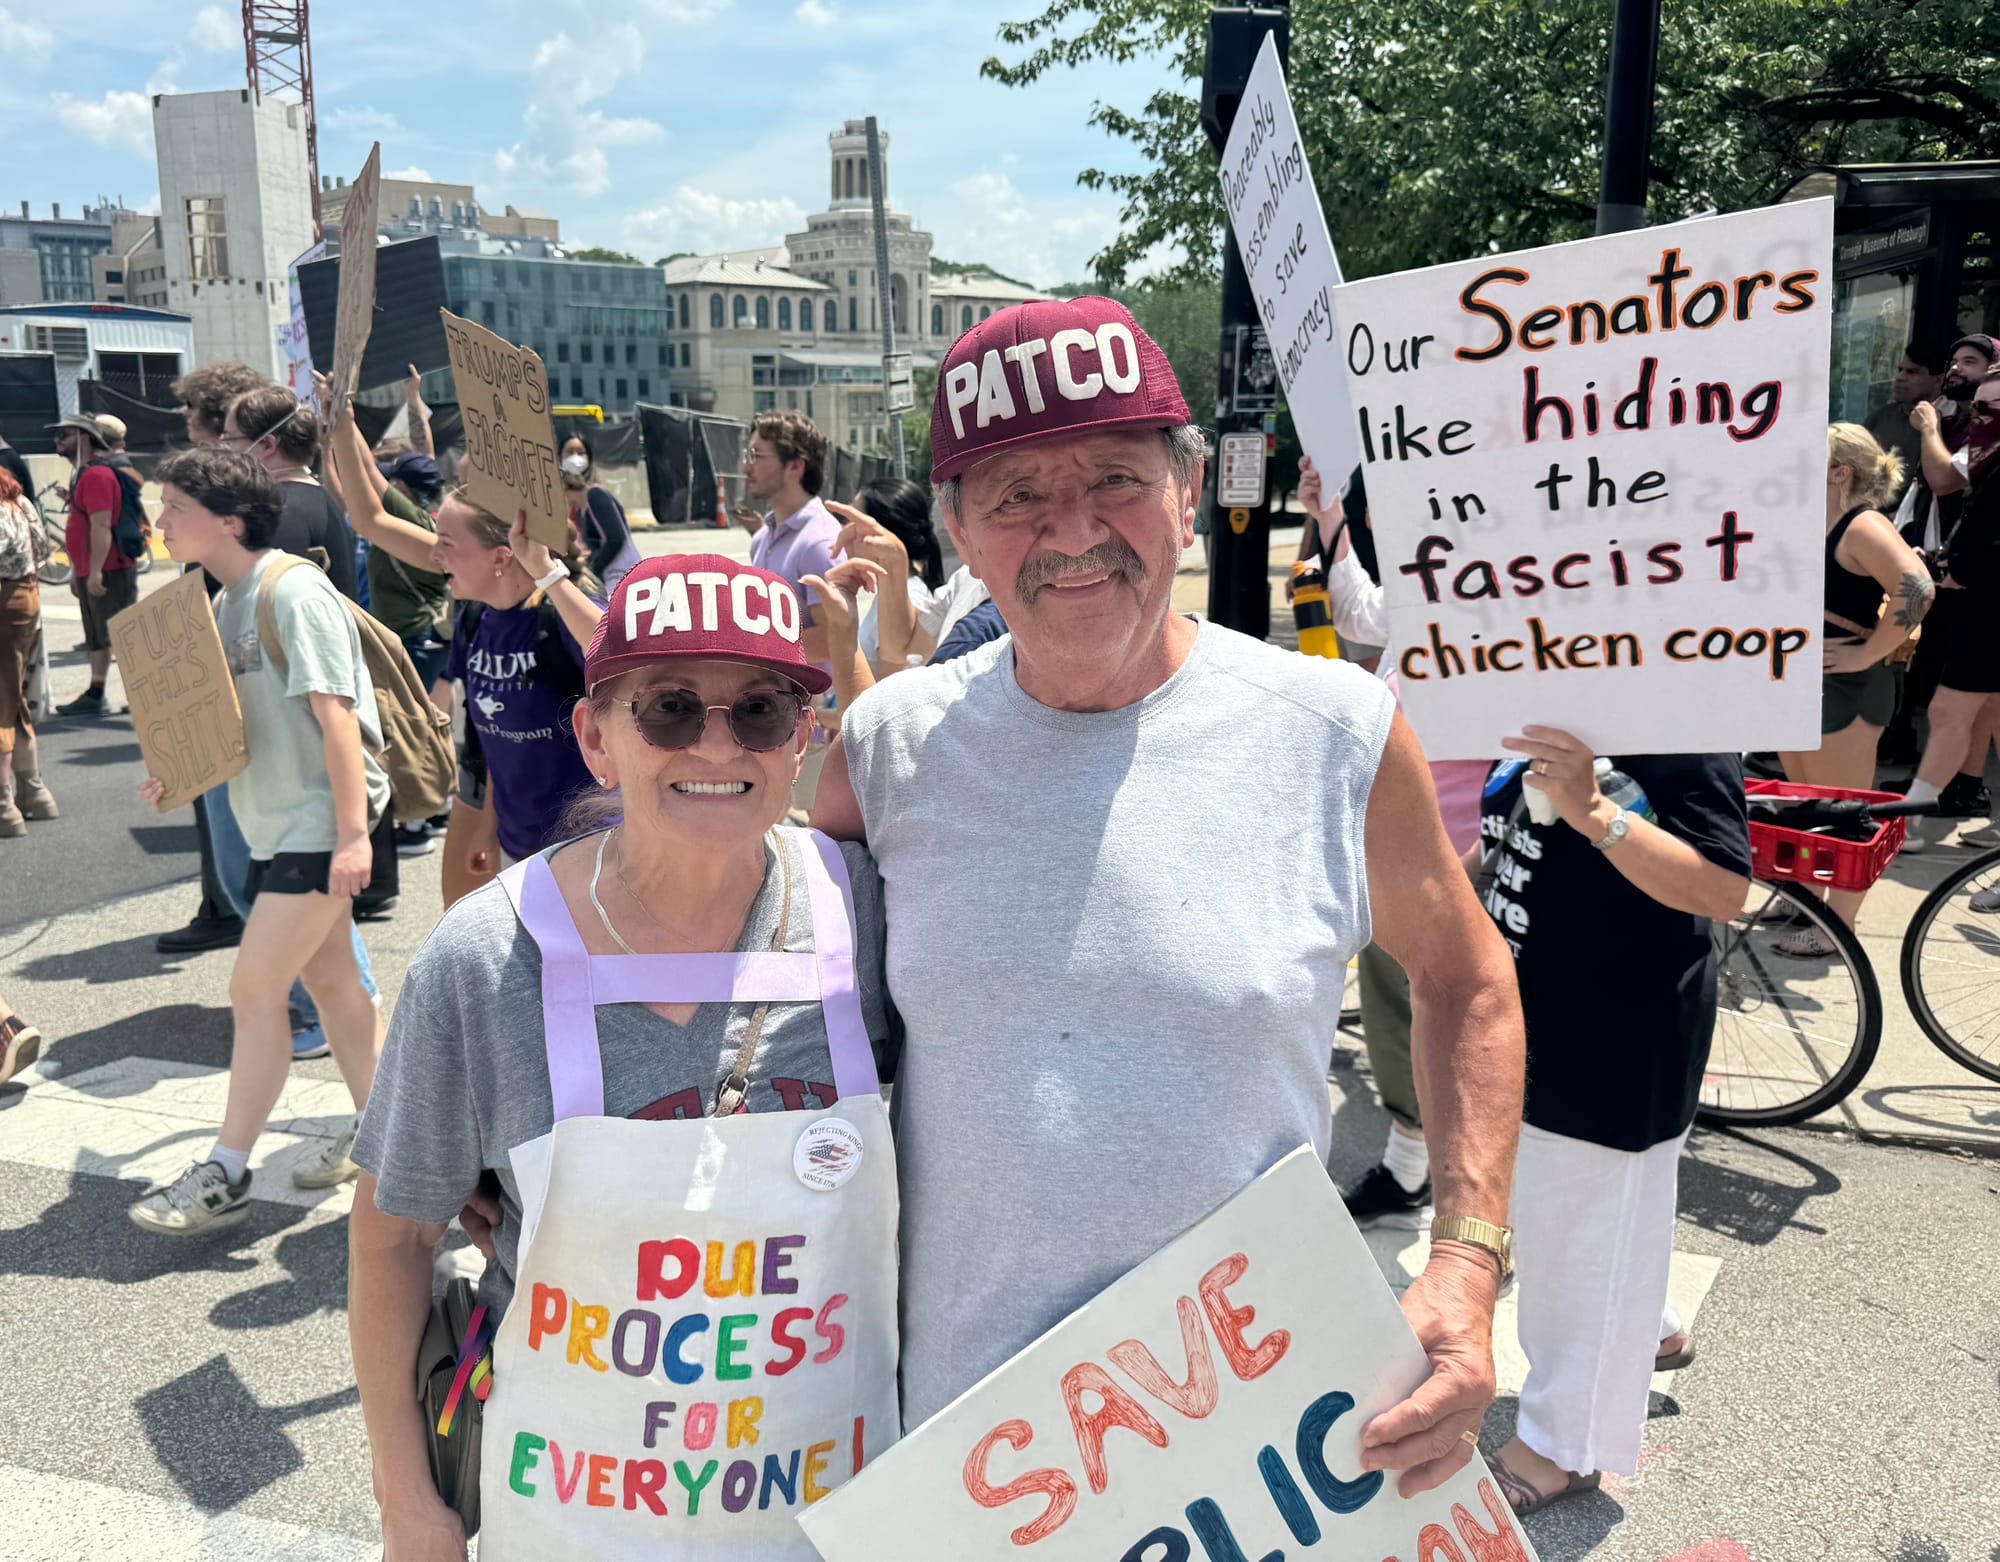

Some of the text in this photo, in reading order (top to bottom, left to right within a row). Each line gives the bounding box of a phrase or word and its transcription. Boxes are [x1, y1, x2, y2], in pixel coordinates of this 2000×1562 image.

[1222, 93, 1275, 224] Peaceably
[1244, 142, 1302, 278] assembling
[1841, 242, 1862, 260] Carnegie
[1863, 237, 1887, 254] Museums
[1897, 222, 1926, 244] Pittsburgh
[1260, 295, 1275, 328] to
[1276, 222, 1307, 294] save
[1348, 323, 1434, 376] Our
[1457, 249, 1818, 361] Senators
[945, 321, 1140, 440] PATCO
[1276, 285, 1333, 394] democracy
[1359, 405, 1475, 463] like
[1523, 357, 1781, 442] hiding
[467, 407, 554, 517] JAGOFF
[1427, 457, 1669, 521] in the
[1399, 511, 1753, 603] fascist
[117, 583, 205, 673] FUCK
[625, 573, 800, 641] PATCO
[1400, 618, 1809, 681] chicken coop
[130, 641, 209, 712] THIS
[490, 723, 552, 743] Program
[803, 1173, 836, 1188] SINCE 1776
[809, 1126, 863, 1153] REJECTING KINGS
[636, 1234, 806, 1302] DUE
[528, 1282, 848, 1385] PROCESS
[644, 1395, 764, 1451] FOR
[963, 1251, 1291, 1545] SAVE
